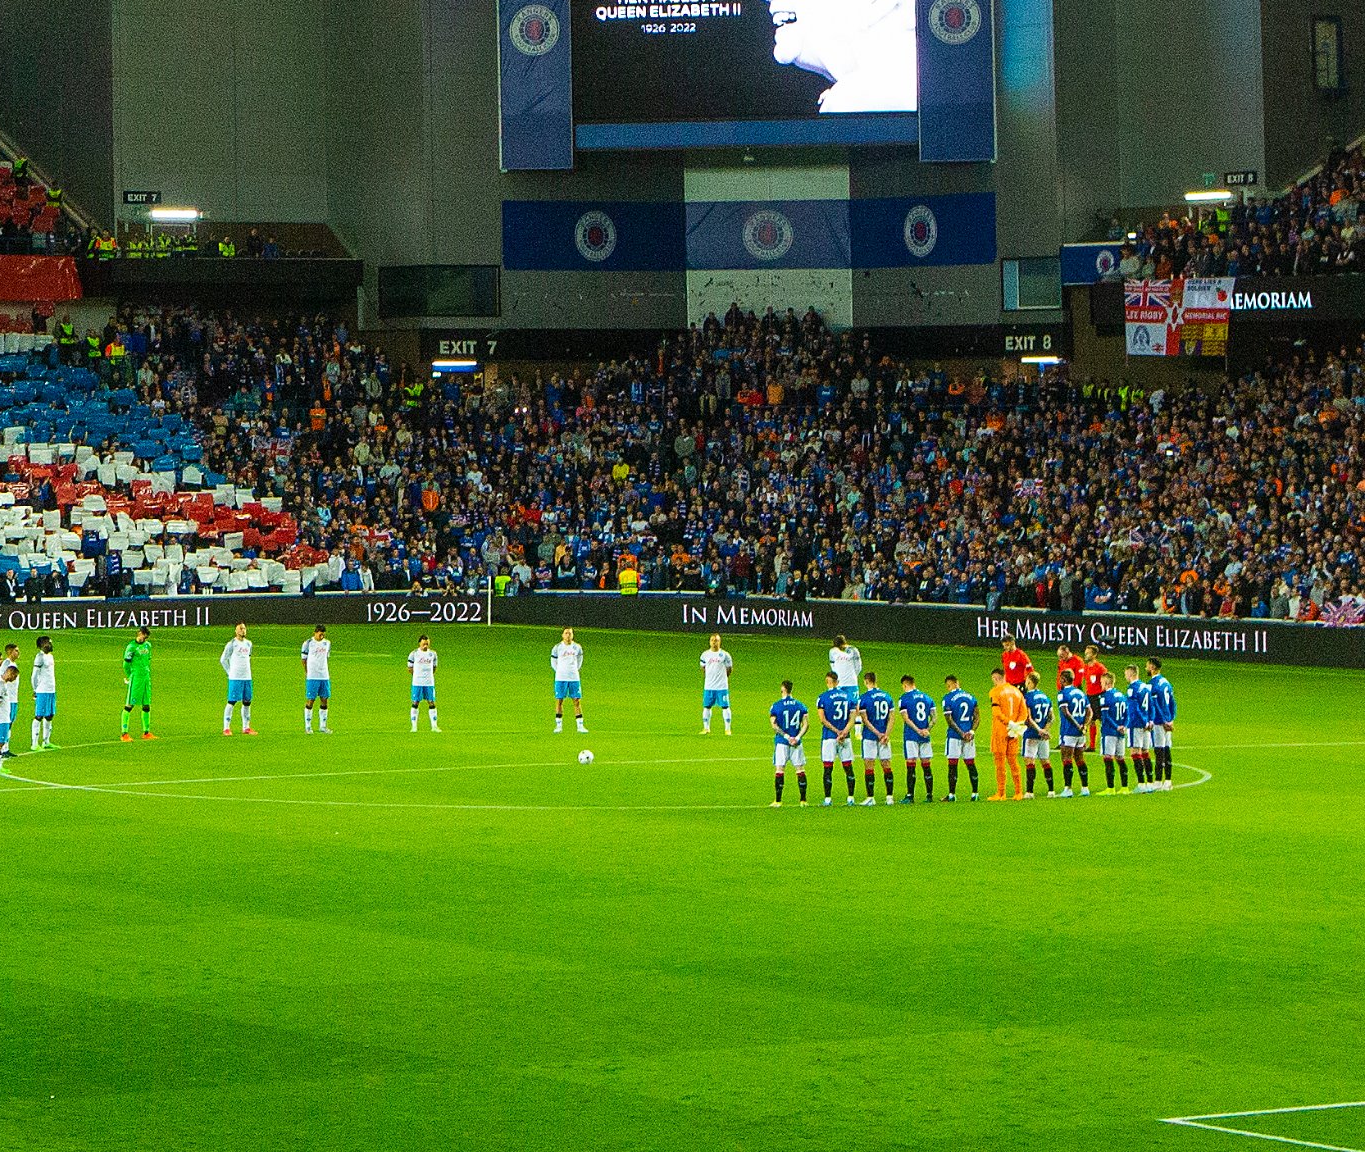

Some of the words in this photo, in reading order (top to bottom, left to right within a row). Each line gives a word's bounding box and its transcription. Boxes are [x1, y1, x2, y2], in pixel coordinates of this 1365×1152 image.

[595, 5, 647, 21] QUEEN
[649, 3, 730, 18] ELIZABETH
[732, 2, 742, 17] II
[640, 23, 666, 34] 1926
[670, 22, 696, 33] 2022
[1226, 173, 1245, 184] EXIT
[127, 193, 148, 202] EXIT
[151, 193, 157, 202] 7
[439, 340, 478, 356] EXIT
[488, 340, 498, 355] 7
[1005, 335, 1039, 351] EXIT
[1043, 335, 1052, 350] 8
[8, 610, 77, 632] QUEEN
[86, 608, 187, 629] ELIZABETH
[196, 606, 211, 626] II
[682, 603, 708, 624] IN
[717, 605, 814, 628] MEMORIAM
[976, 616, 1010, 639] HER
[1015, 619, 1086, 644] MAJESTY
[1090, 622, 1149, 649] QUEEN
[1156, 625, 1247, 652] ELIZABETH
[1254, 631, 1268, 653] II
[832, 700, 848, 721] 31
[873, 700, 889, 721] 19
[915, 701, 927, 722] 8
[959, 701, 970, 722] 2
[1008, 696, 1014, 718] 1
[1071, 697, 1086, 717] 20
[1114, 701, 1126, 721] 10
[1141, 692, 1149, 712] 4
[782, 709, 801, 730] 14
[1034, 703, 1050, 723] 37
